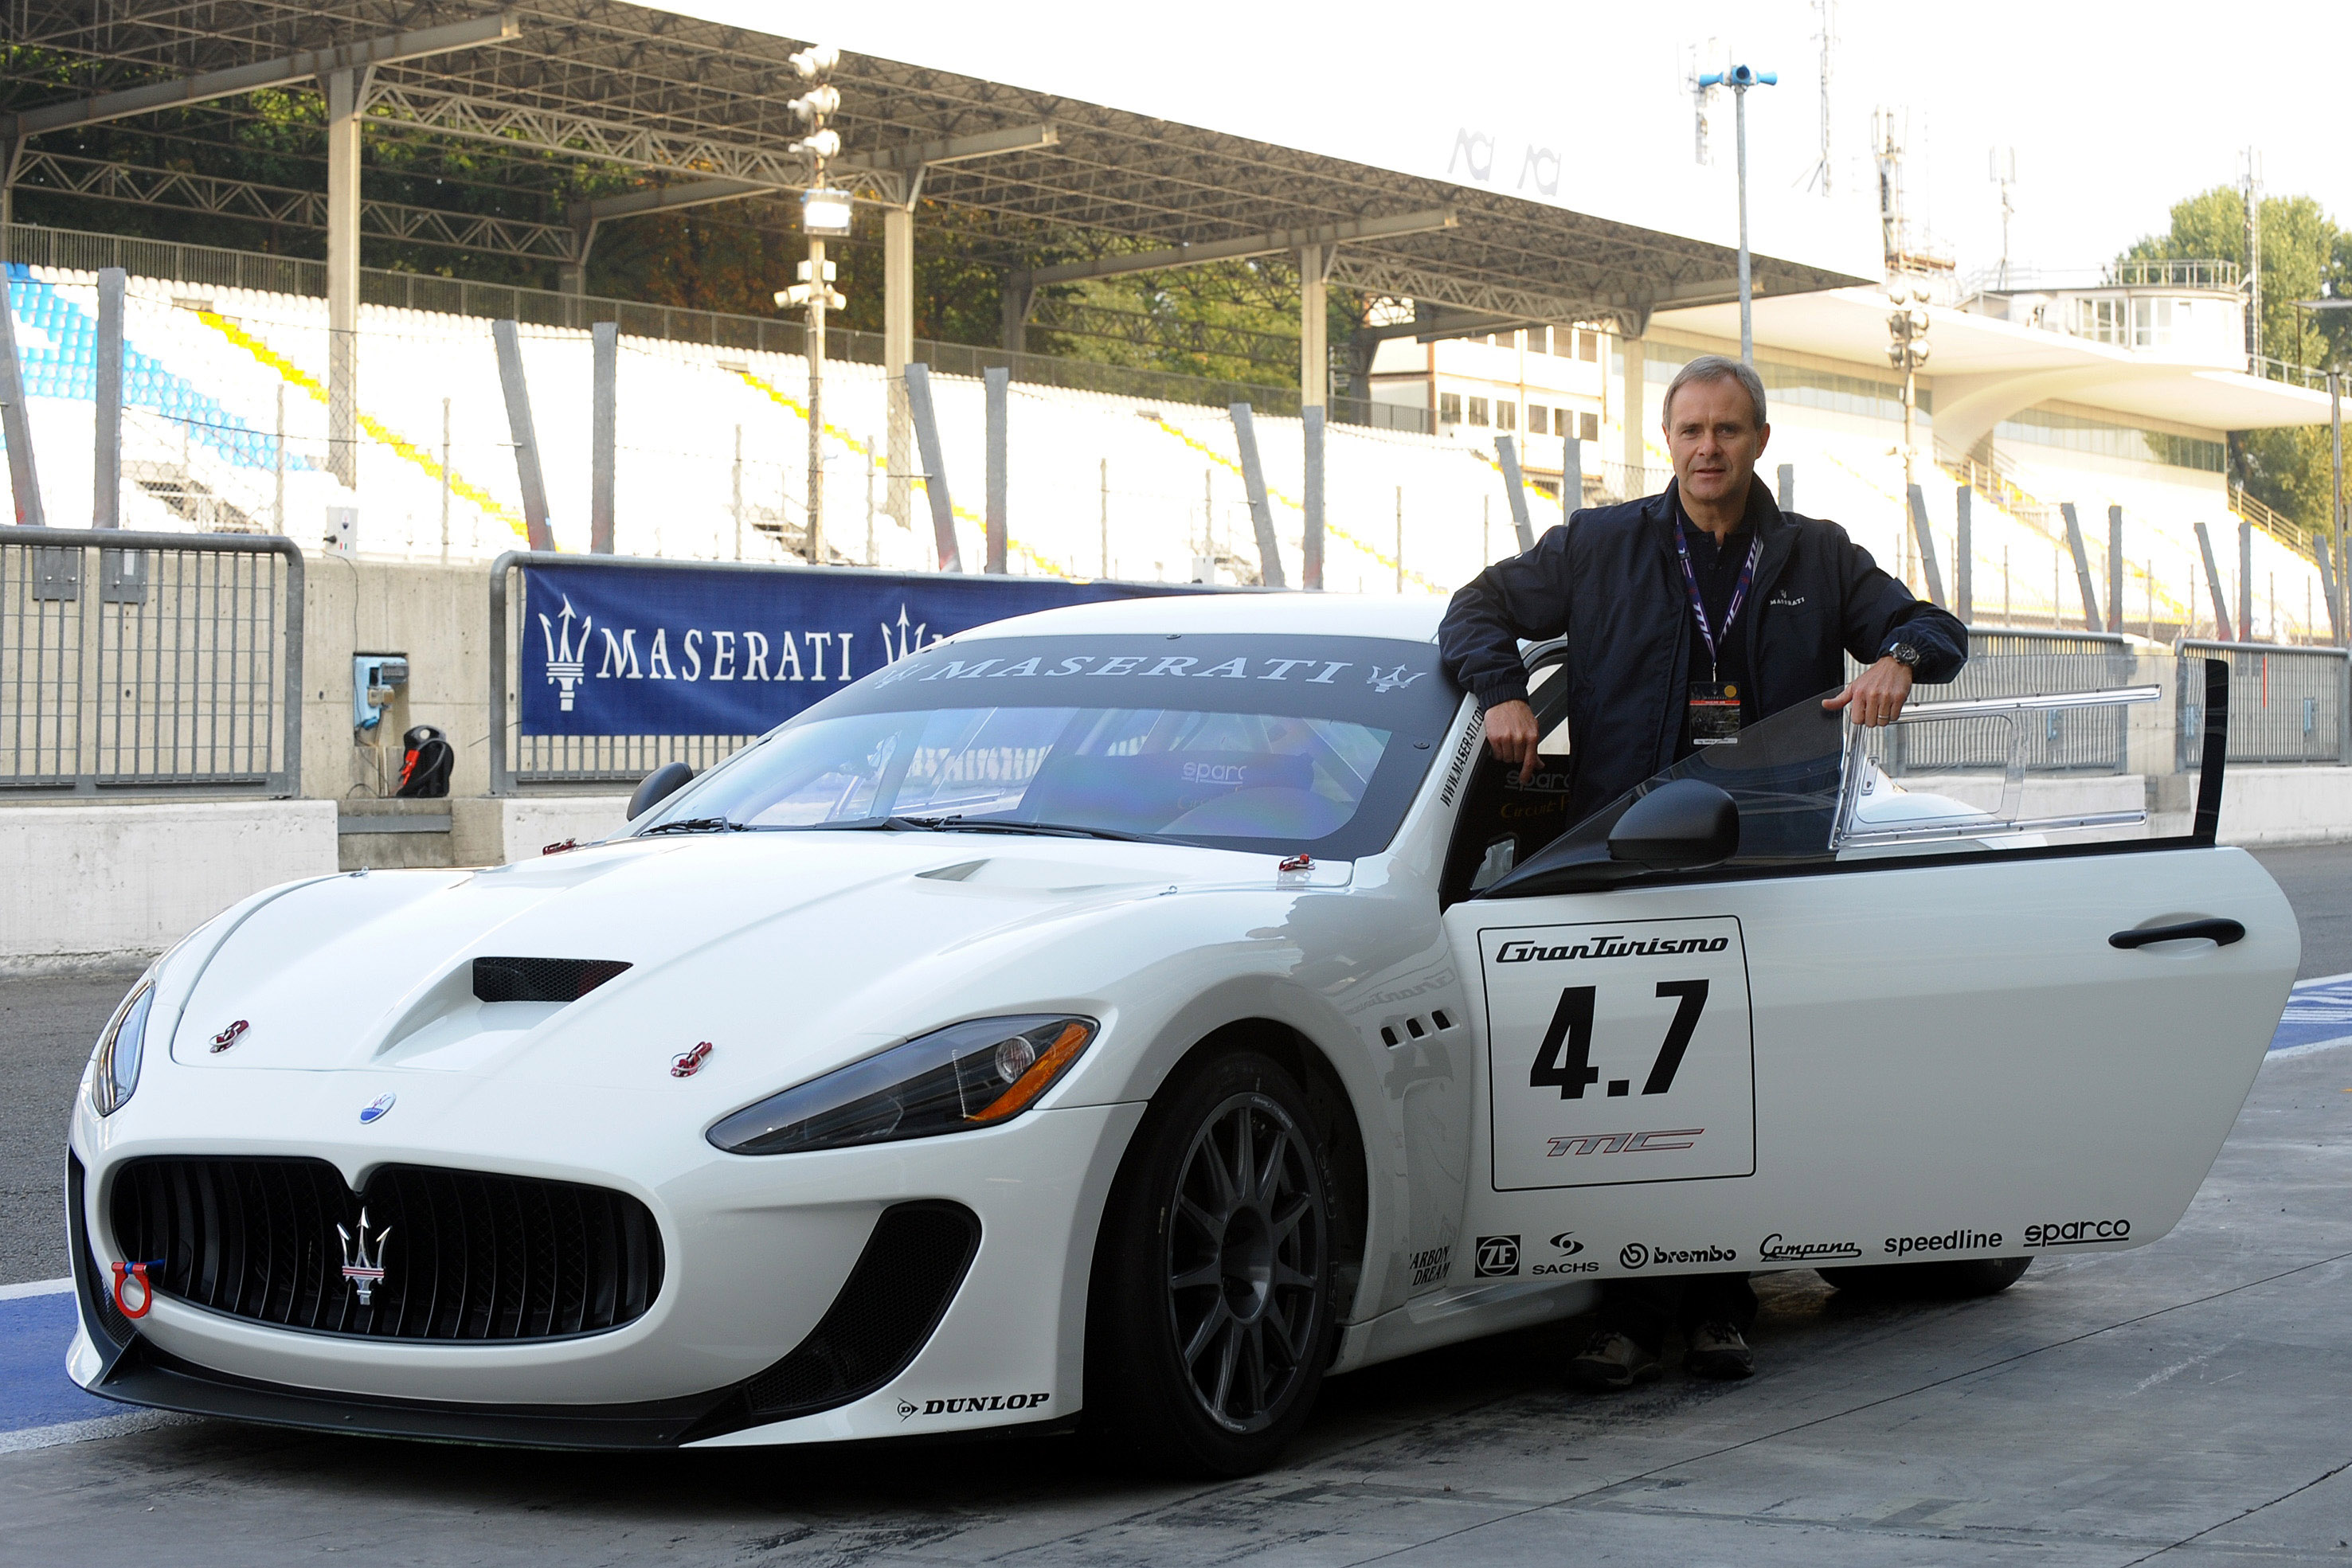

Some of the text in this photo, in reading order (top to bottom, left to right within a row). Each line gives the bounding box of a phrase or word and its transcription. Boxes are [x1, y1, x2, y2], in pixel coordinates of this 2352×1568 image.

[597, 628, 854, 682] MASERATI
[920, 655, 1353, 685] MASERATI
[1497, 936, 1729, 964] GranTurismo
[1529, 979, 1710, 1100] 4.7
[1884, 1230, 2003, 1257] speedline
[2023, 1219, 2131, 1248] sparco
[1410, 1245, 1450, 1270] ARBON
[1481, 1245, 1516, 1269] ZF
[1532, 1261, 1599, 1275] SACHS
[1653, 1245, 1736, 1265] brembo
[1412, 1262, 1450, 1286] DREAM
[922, 1393, 1050, 1415] DUNLOP
